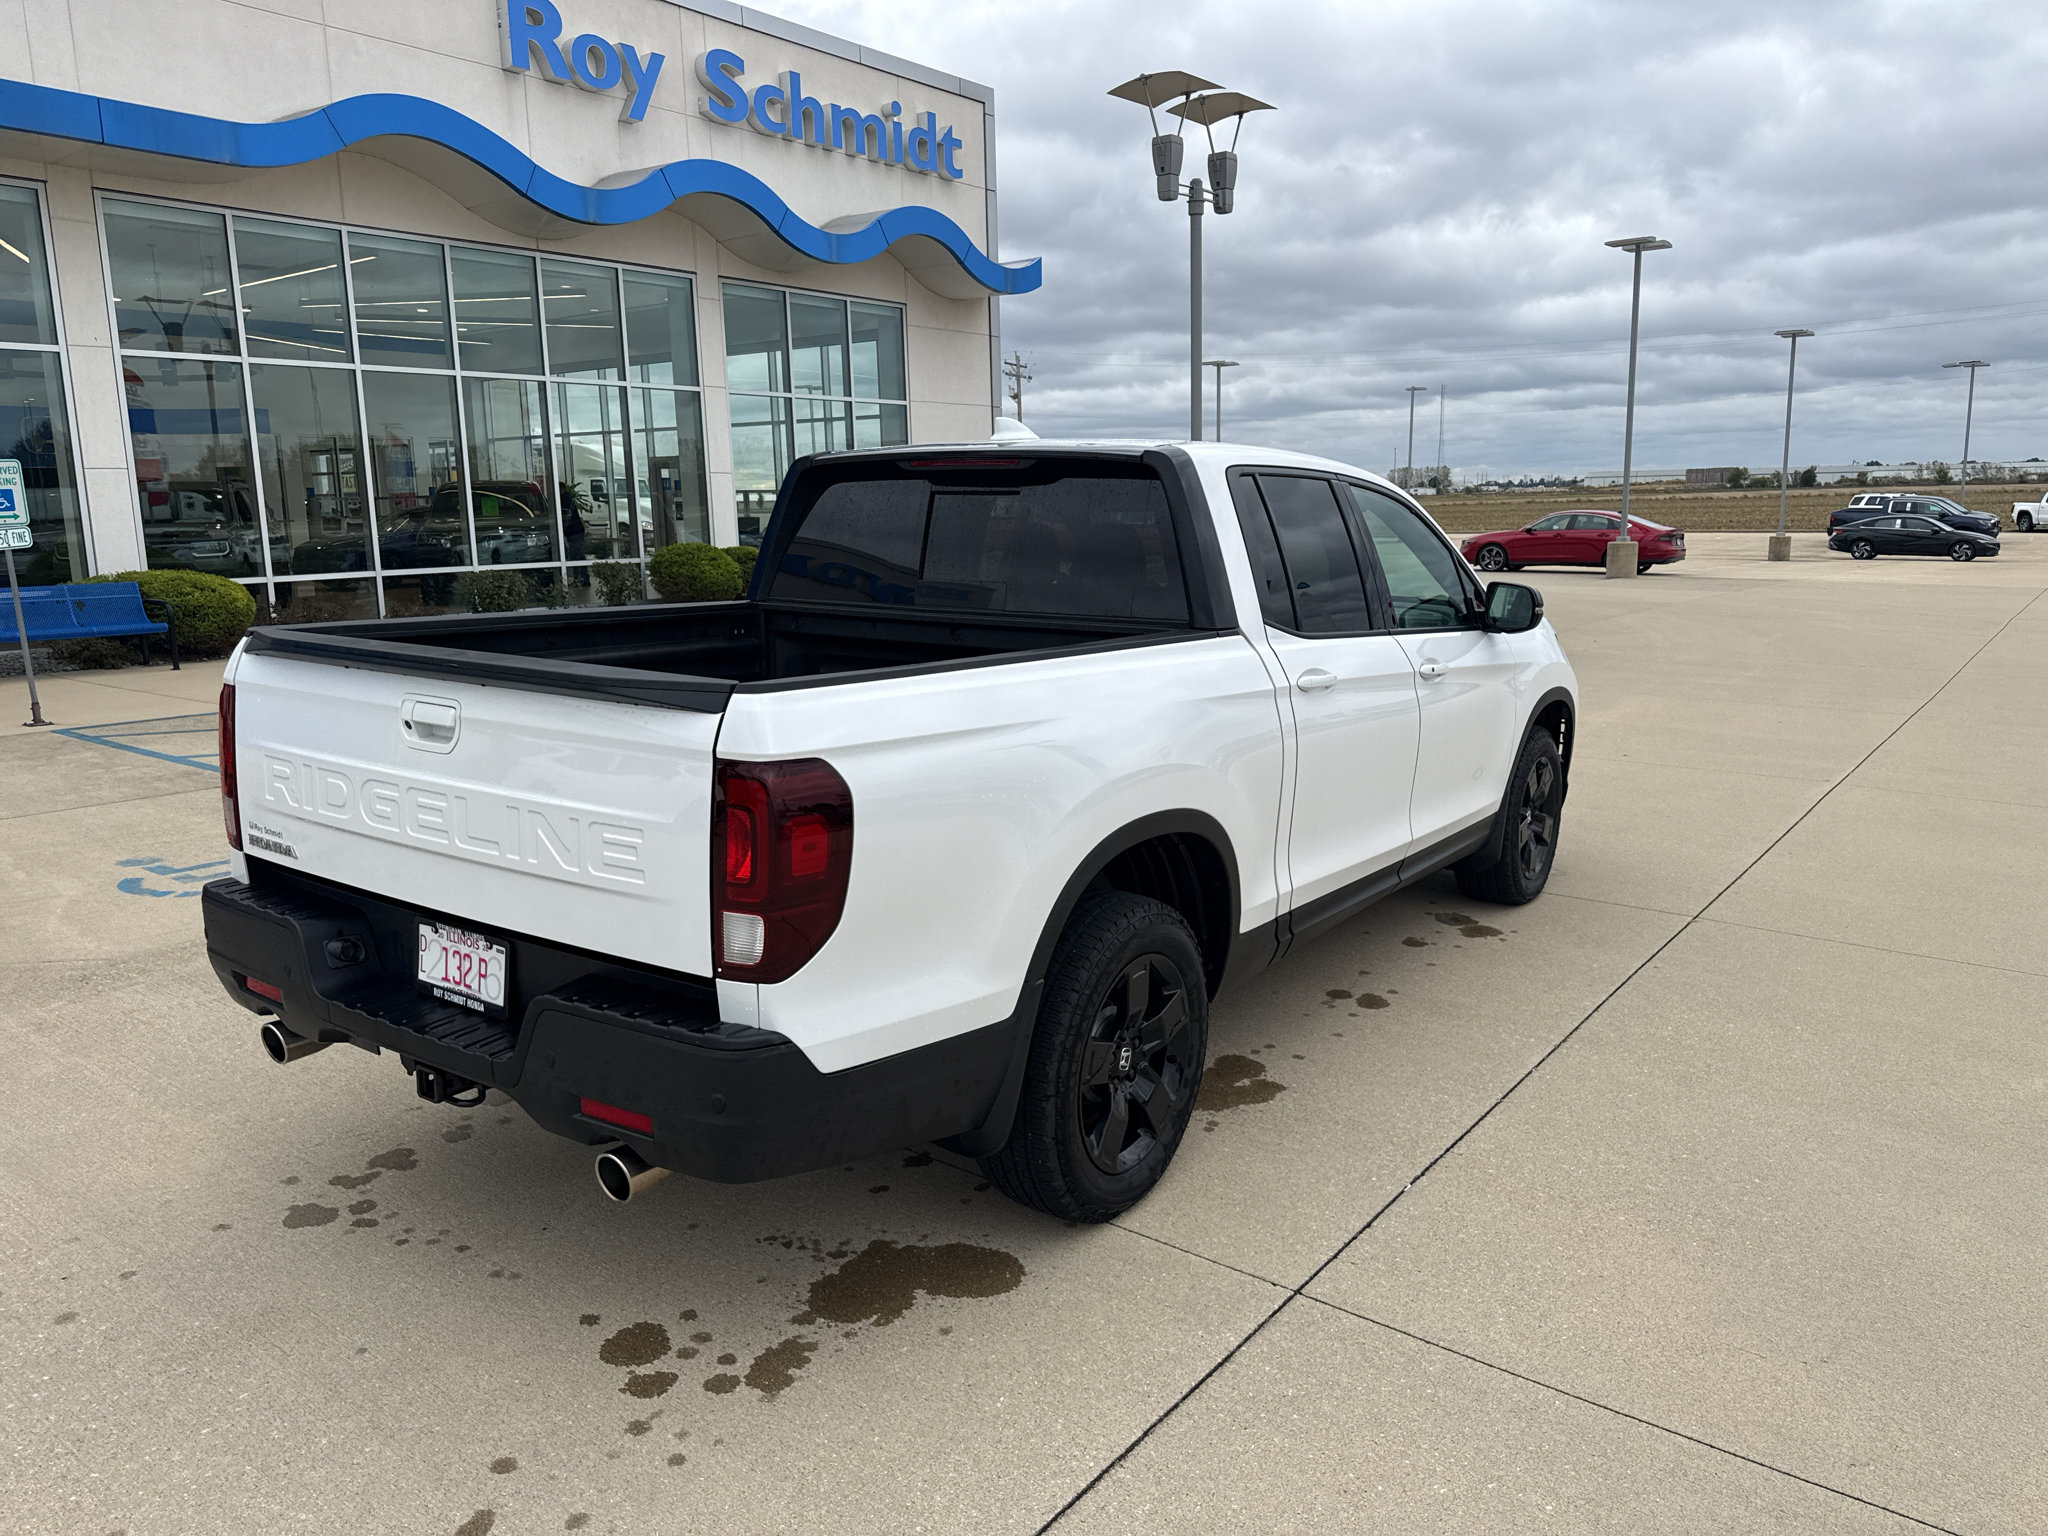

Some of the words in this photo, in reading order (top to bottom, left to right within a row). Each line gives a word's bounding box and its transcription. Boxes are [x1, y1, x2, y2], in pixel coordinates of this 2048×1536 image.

[501, 0, 665, 123] Roy
[696, 48, 963, 180] Schmidt
[12, 531, 28, 544] FINE
[254, 823, 263, 834] Roy
[264, 754, 645, 884] RIDGELINE
[446, 931, 480, 950] ILLINOIS
[441, 946, 473, 989] 132
[478, 957, 488, 993] P
[433, 987, 444, 999] ROY
[444, 990, 467, 1006] SCHMIDT
[467, 998, 485, 1013] HONDA
